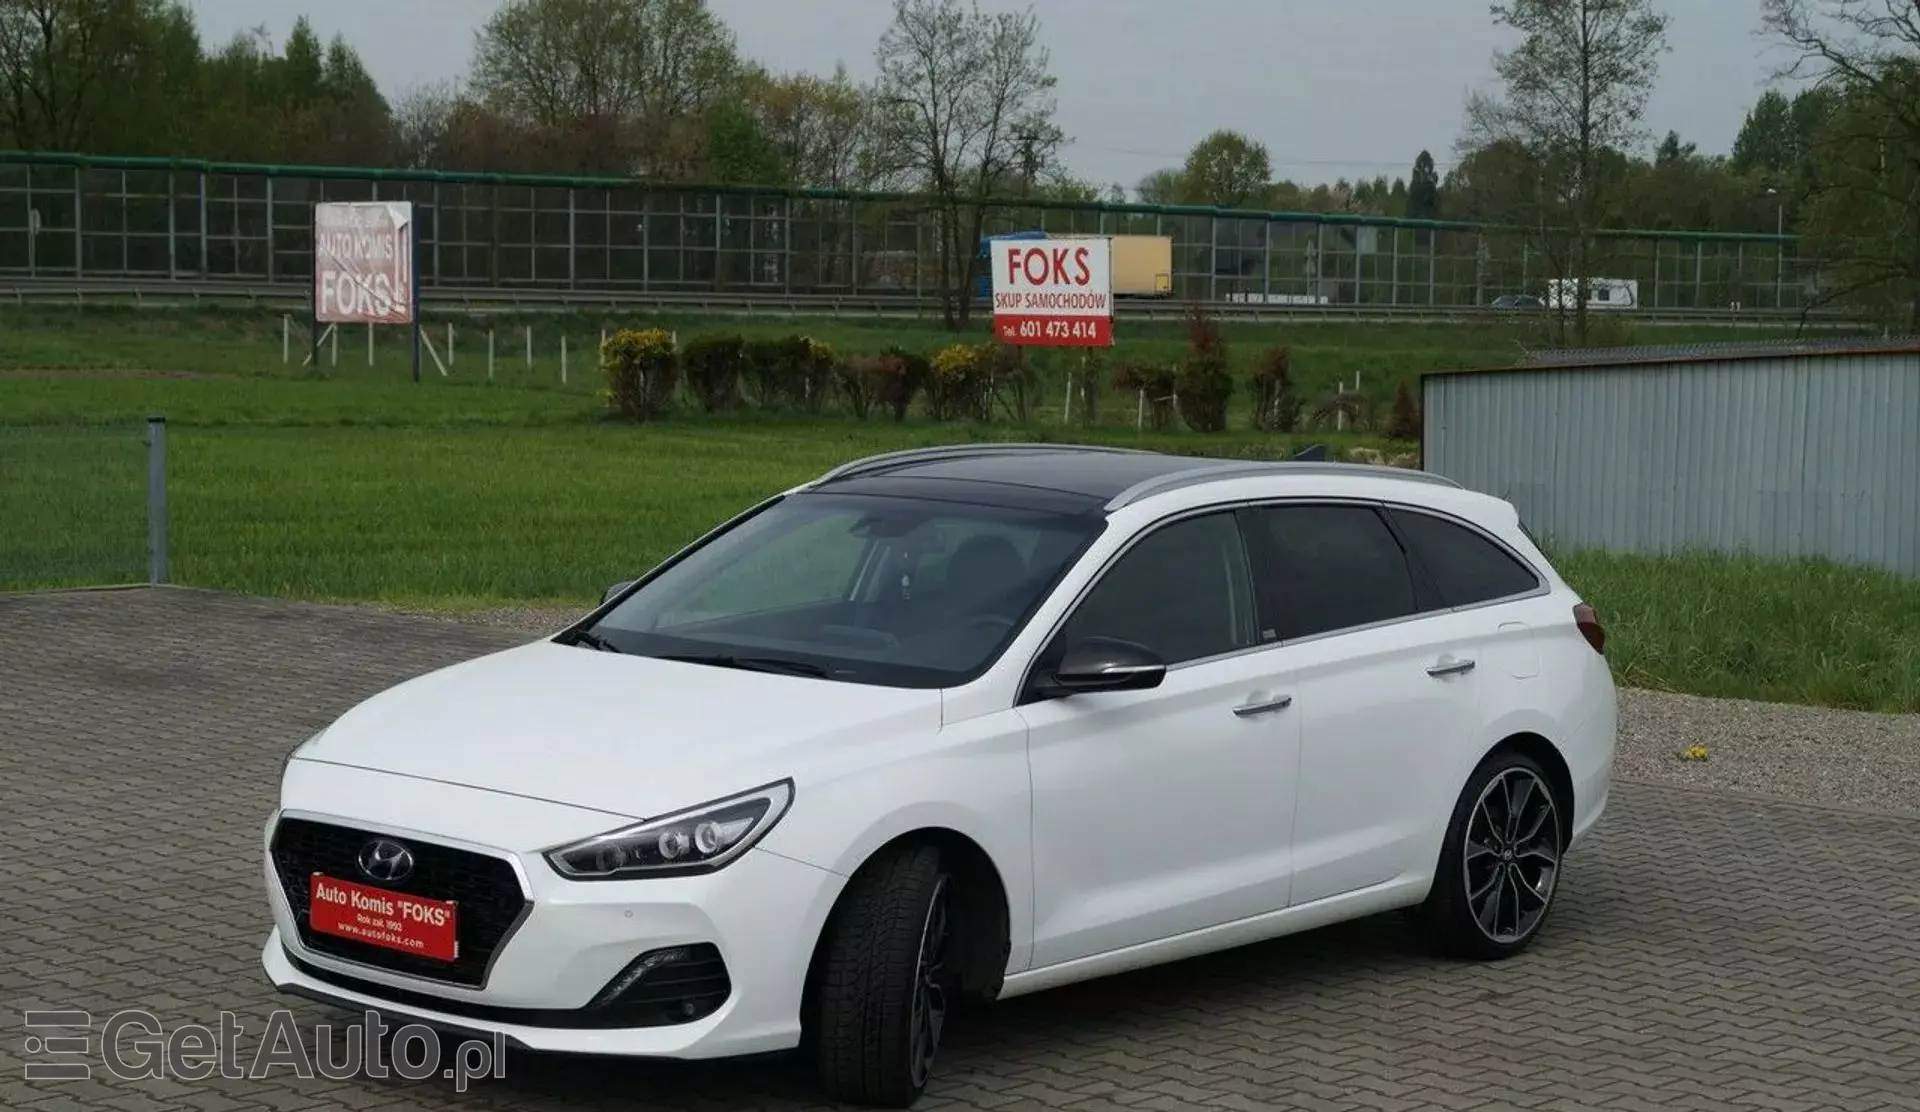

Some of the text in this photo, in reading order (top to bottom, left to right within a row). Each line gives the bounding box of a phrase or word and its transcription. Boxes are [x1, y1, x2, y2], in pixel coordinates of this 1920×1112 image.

[318, 233, 352, 258] AUTO
[1008, 247, 1090, 286] FOKS
[321, 270, 392, 316] FOKS
[995, 289, 1106, 309] SKUP SAMOCHODÓW
[1020, 320, 1041, 337] 601
[1046, 321, 1069, 338] 473
[1072, 321, 1097, 339] 414
[316, 883, 451, 927] Auto Komis "FOKS"
[356, 913, 371, 925] Rok
[337, 922, 425, 949] www.autofoks.com
